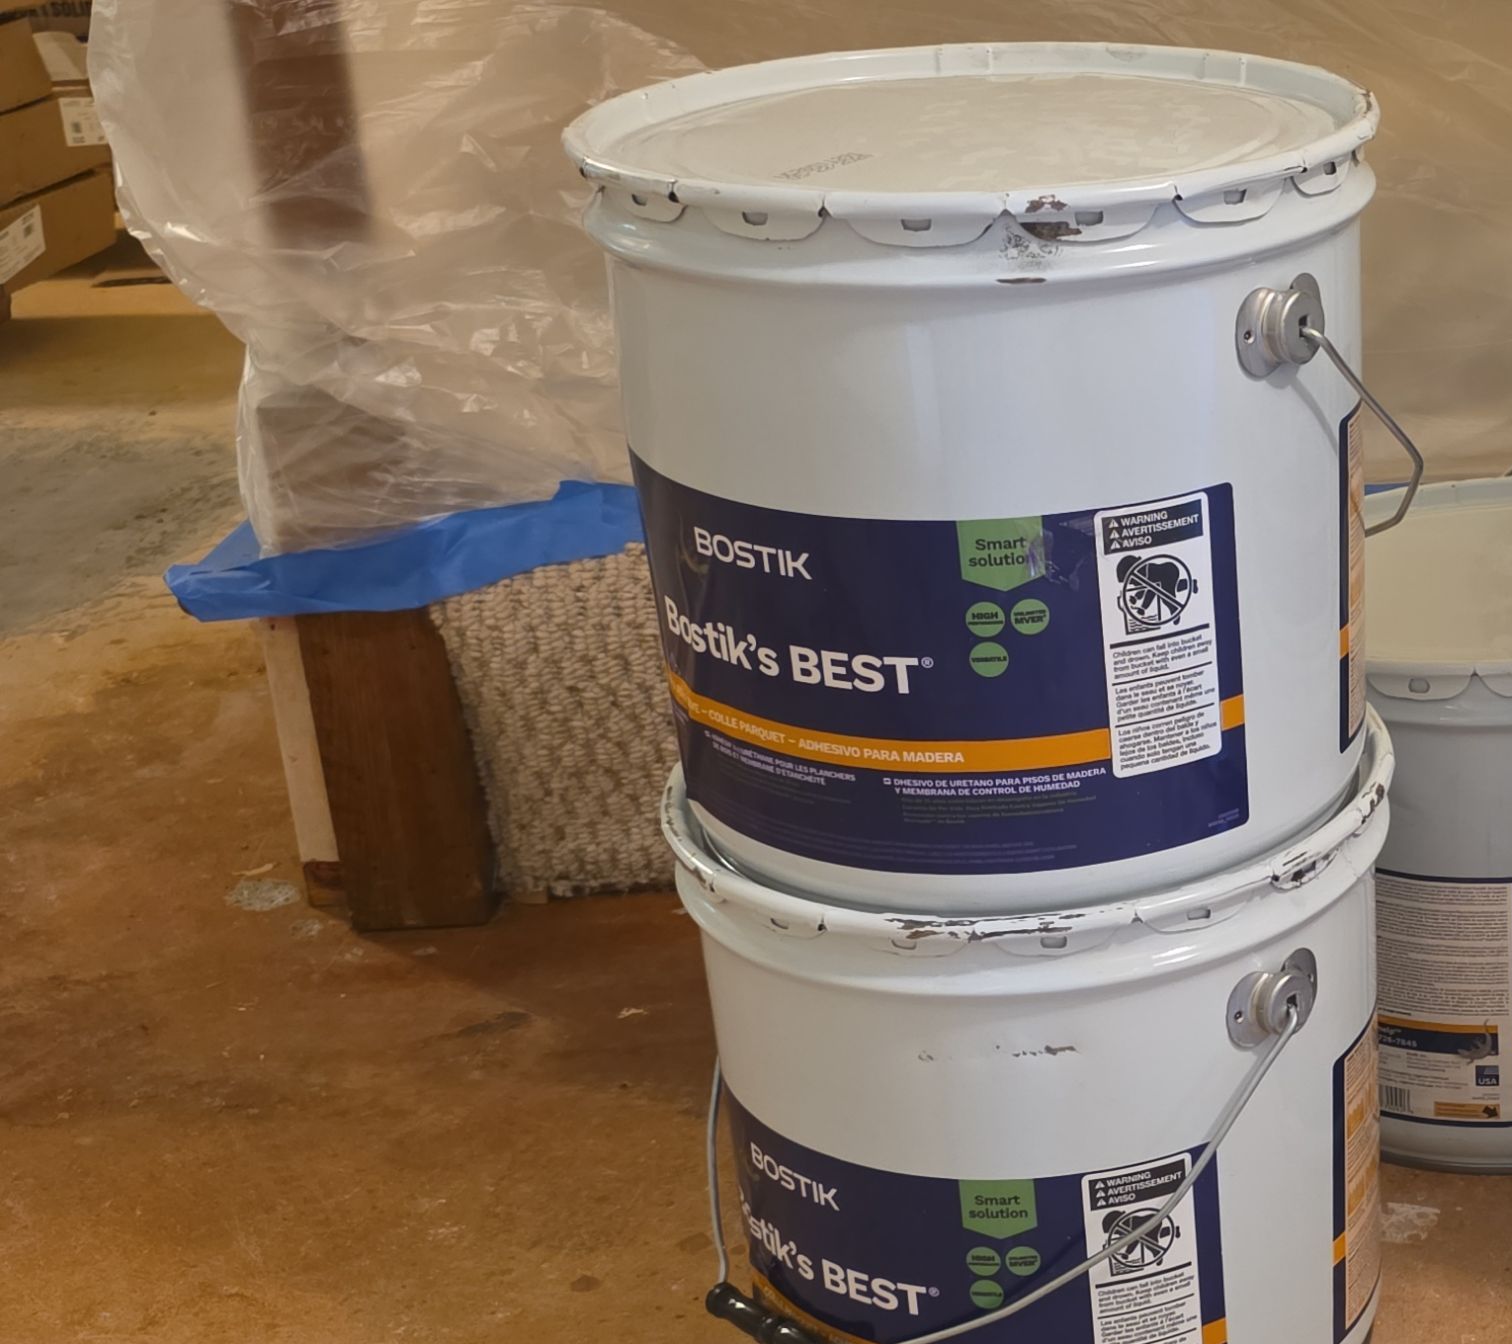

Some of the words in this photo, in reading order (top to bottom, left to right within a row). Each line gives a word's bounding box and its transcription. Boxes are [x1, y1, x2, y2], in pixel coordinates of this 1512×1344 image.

[1121, 511, 1167, 526] WARNING
[1122, 514, 1199, 537] AVERTISSEMENT
[975, 537, 1026, 550] Smart
[1122, 536, 1152, 547] AVISO
[694, 526, 812, 580] BOSTIK
[969, 554, 1029, 567] solutio
[972, 612, 998, 620] HIGH
[709, 710, 738, 728] COLLE
[740, 720, 785, 743] PARQUET
[798, 738, 860, 757] ADHESIVO
[864, 749, 900, 761] PARA
[903, 751, 964, 763] MADERA
[935, 779, 948, 788] DE
[950, 778, 993, 788] URETANO
[995, 777, 1019, 786] PARA
[1022, 774, 1050, 784] PISOS
[1052, 773, 1065, 782] DE
[1066, 767, 1106, 780] MADERA
[902, 787, 956, 796] MEMBRANA
[958, 787, 970, 795] DE
[972, 786, 1016, 796] CONTROL
[1019, 785, 1032, 793] DE
[1034, 781, 1081, 792] HUMEDAD
[751, 1142, 840, 1211] BOSTIK
[1107, 1172, 1151, 1187] WARNING
[1107, 1171, 1182, 1196] AVERTISSEMENT
[975, 1195, 1020, 1206] Smart
[1108, 1193, 1136, 1204] AVISO
[969, 1208, 1028, 1219] solution
